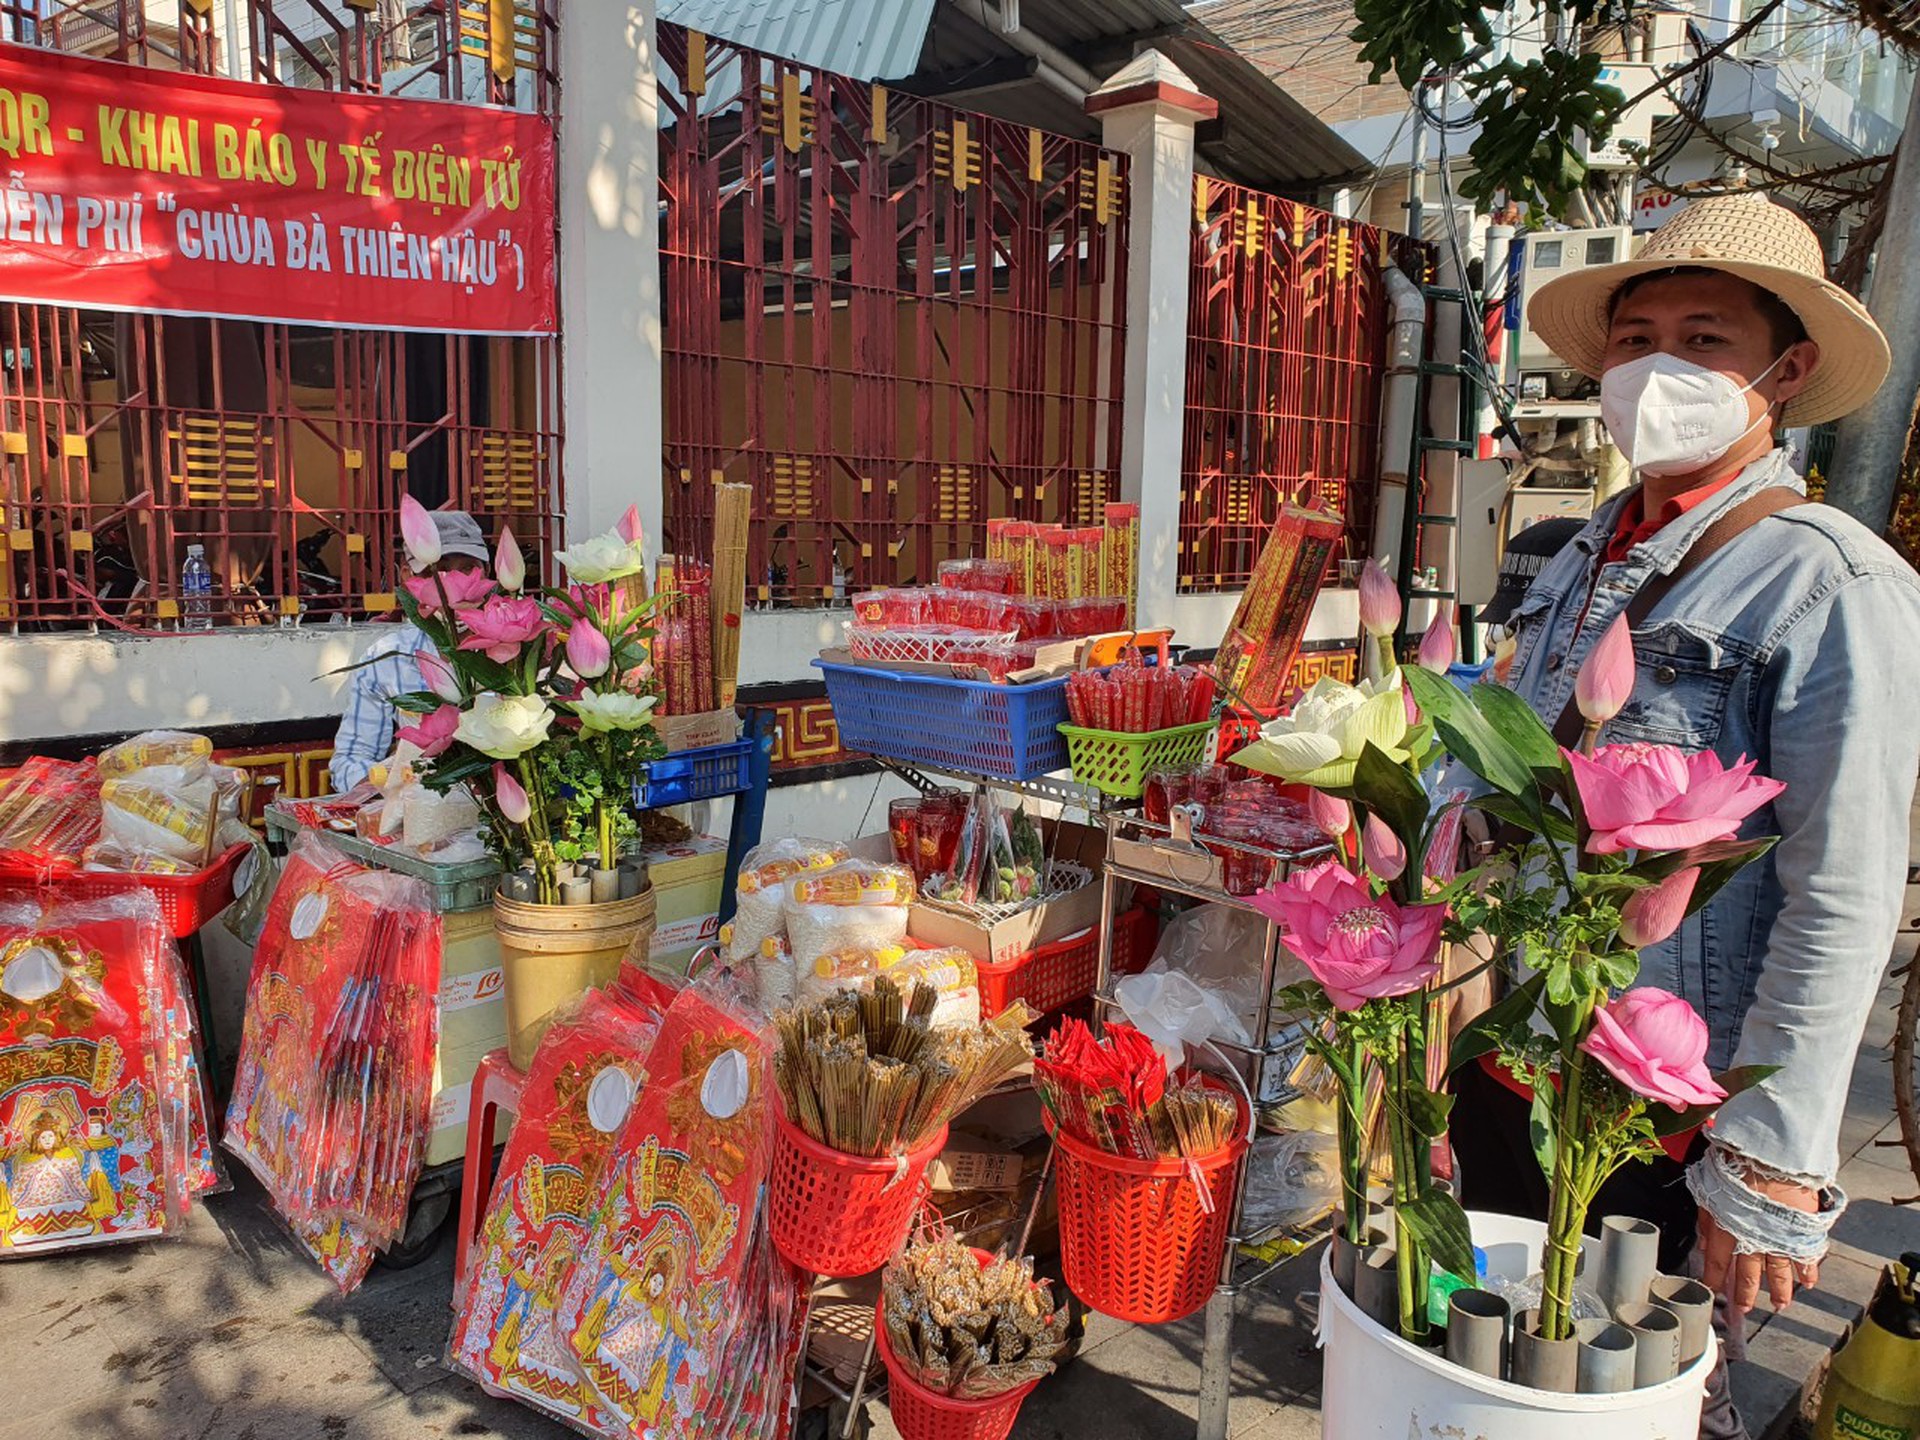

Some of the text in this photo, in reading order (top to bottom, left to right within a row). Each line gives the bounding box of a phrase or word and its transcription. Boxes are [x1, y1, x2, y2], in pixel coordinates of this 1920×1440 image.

[0, 87, 55, 159] QR
[98, 104, 203, 178] KHAI
[214, 118, 298, 187] BÁO
[305, 138, 328, 190] Y
[338, 131, 384, 197] TẾ
[392, 143, 472, 216] ĐIỆN
[480, 144, 522, 211] TỬ
[76, 192, 144, 254] PHÍ
[284, 212, 331, 272] BÀ
[340, 221, 433, 281] THIÊN
